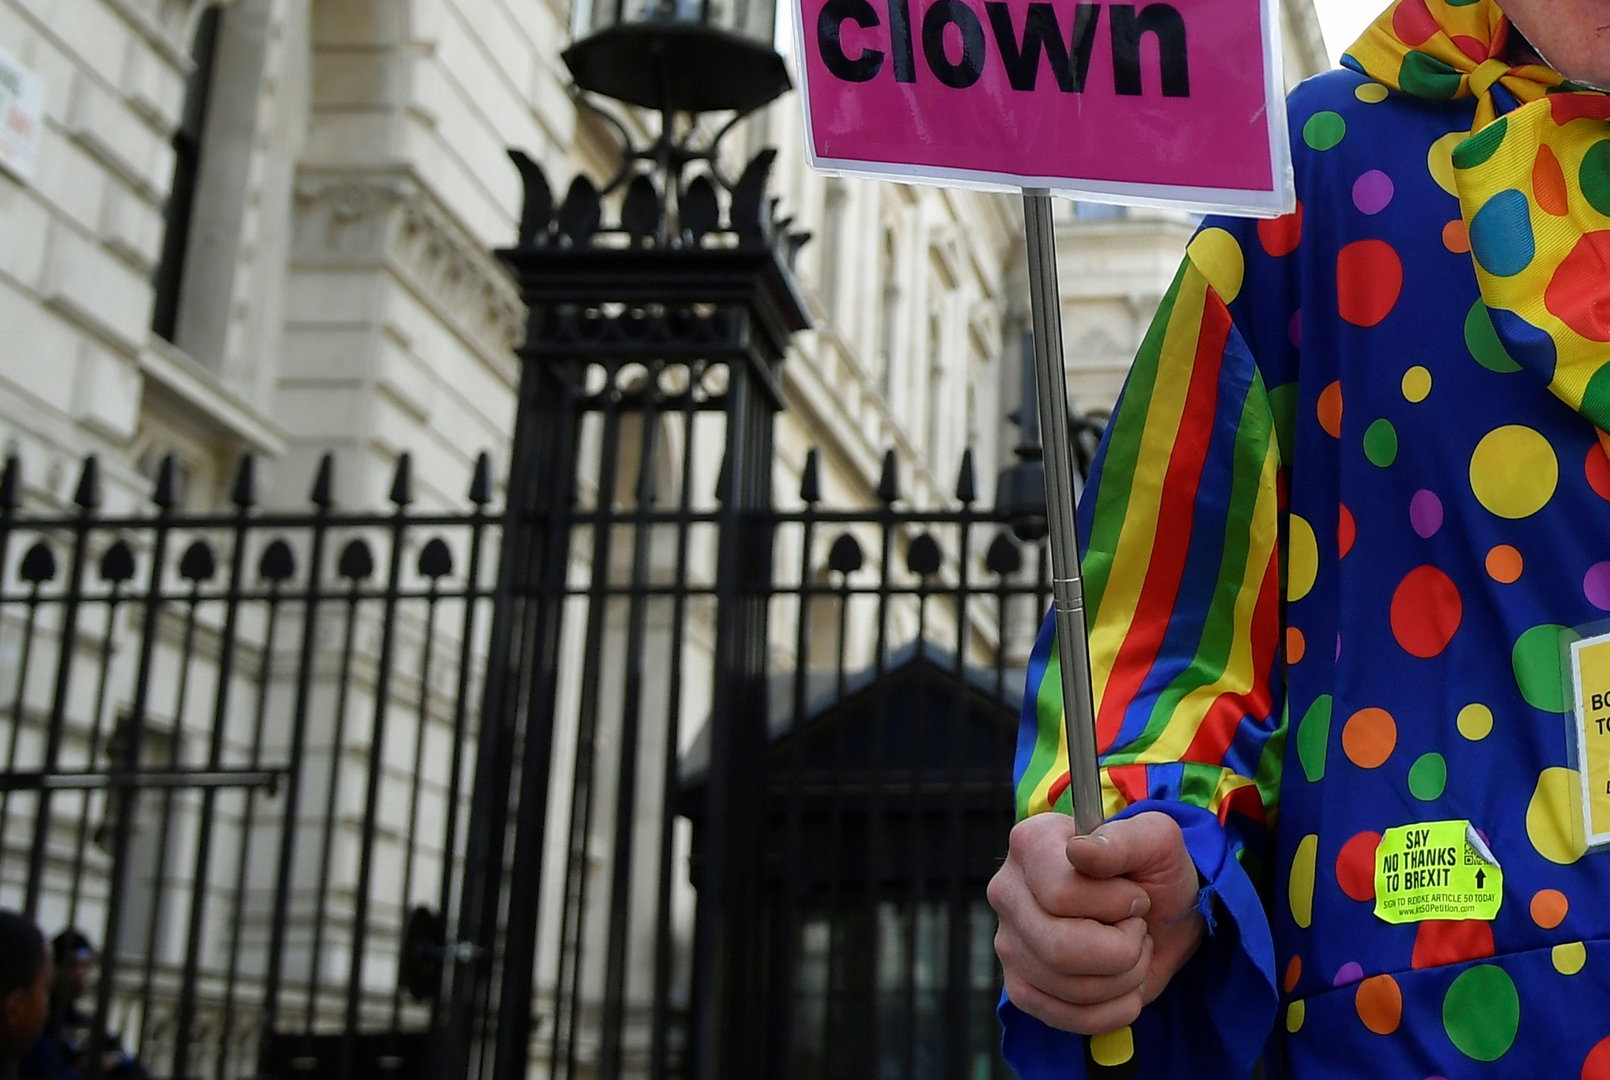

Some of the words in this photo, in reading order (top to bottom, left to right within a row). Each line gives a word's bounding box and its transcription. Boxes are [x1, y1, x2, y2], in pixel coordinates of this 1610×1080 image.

[1406, 829, 1430, 849] SAY
[1383, 854, 1399, 873] NO
[1403, 847, 1456, 869] THANKS
[1386, 874, 1399, 893] TO
[1405, 869, 1450, 890] BREXIT
[1431, 894, 1461, 903] ARTICLE
[1464, 894, 1473, 902] 50
[1474, 894, 1495, 902] TODAY
